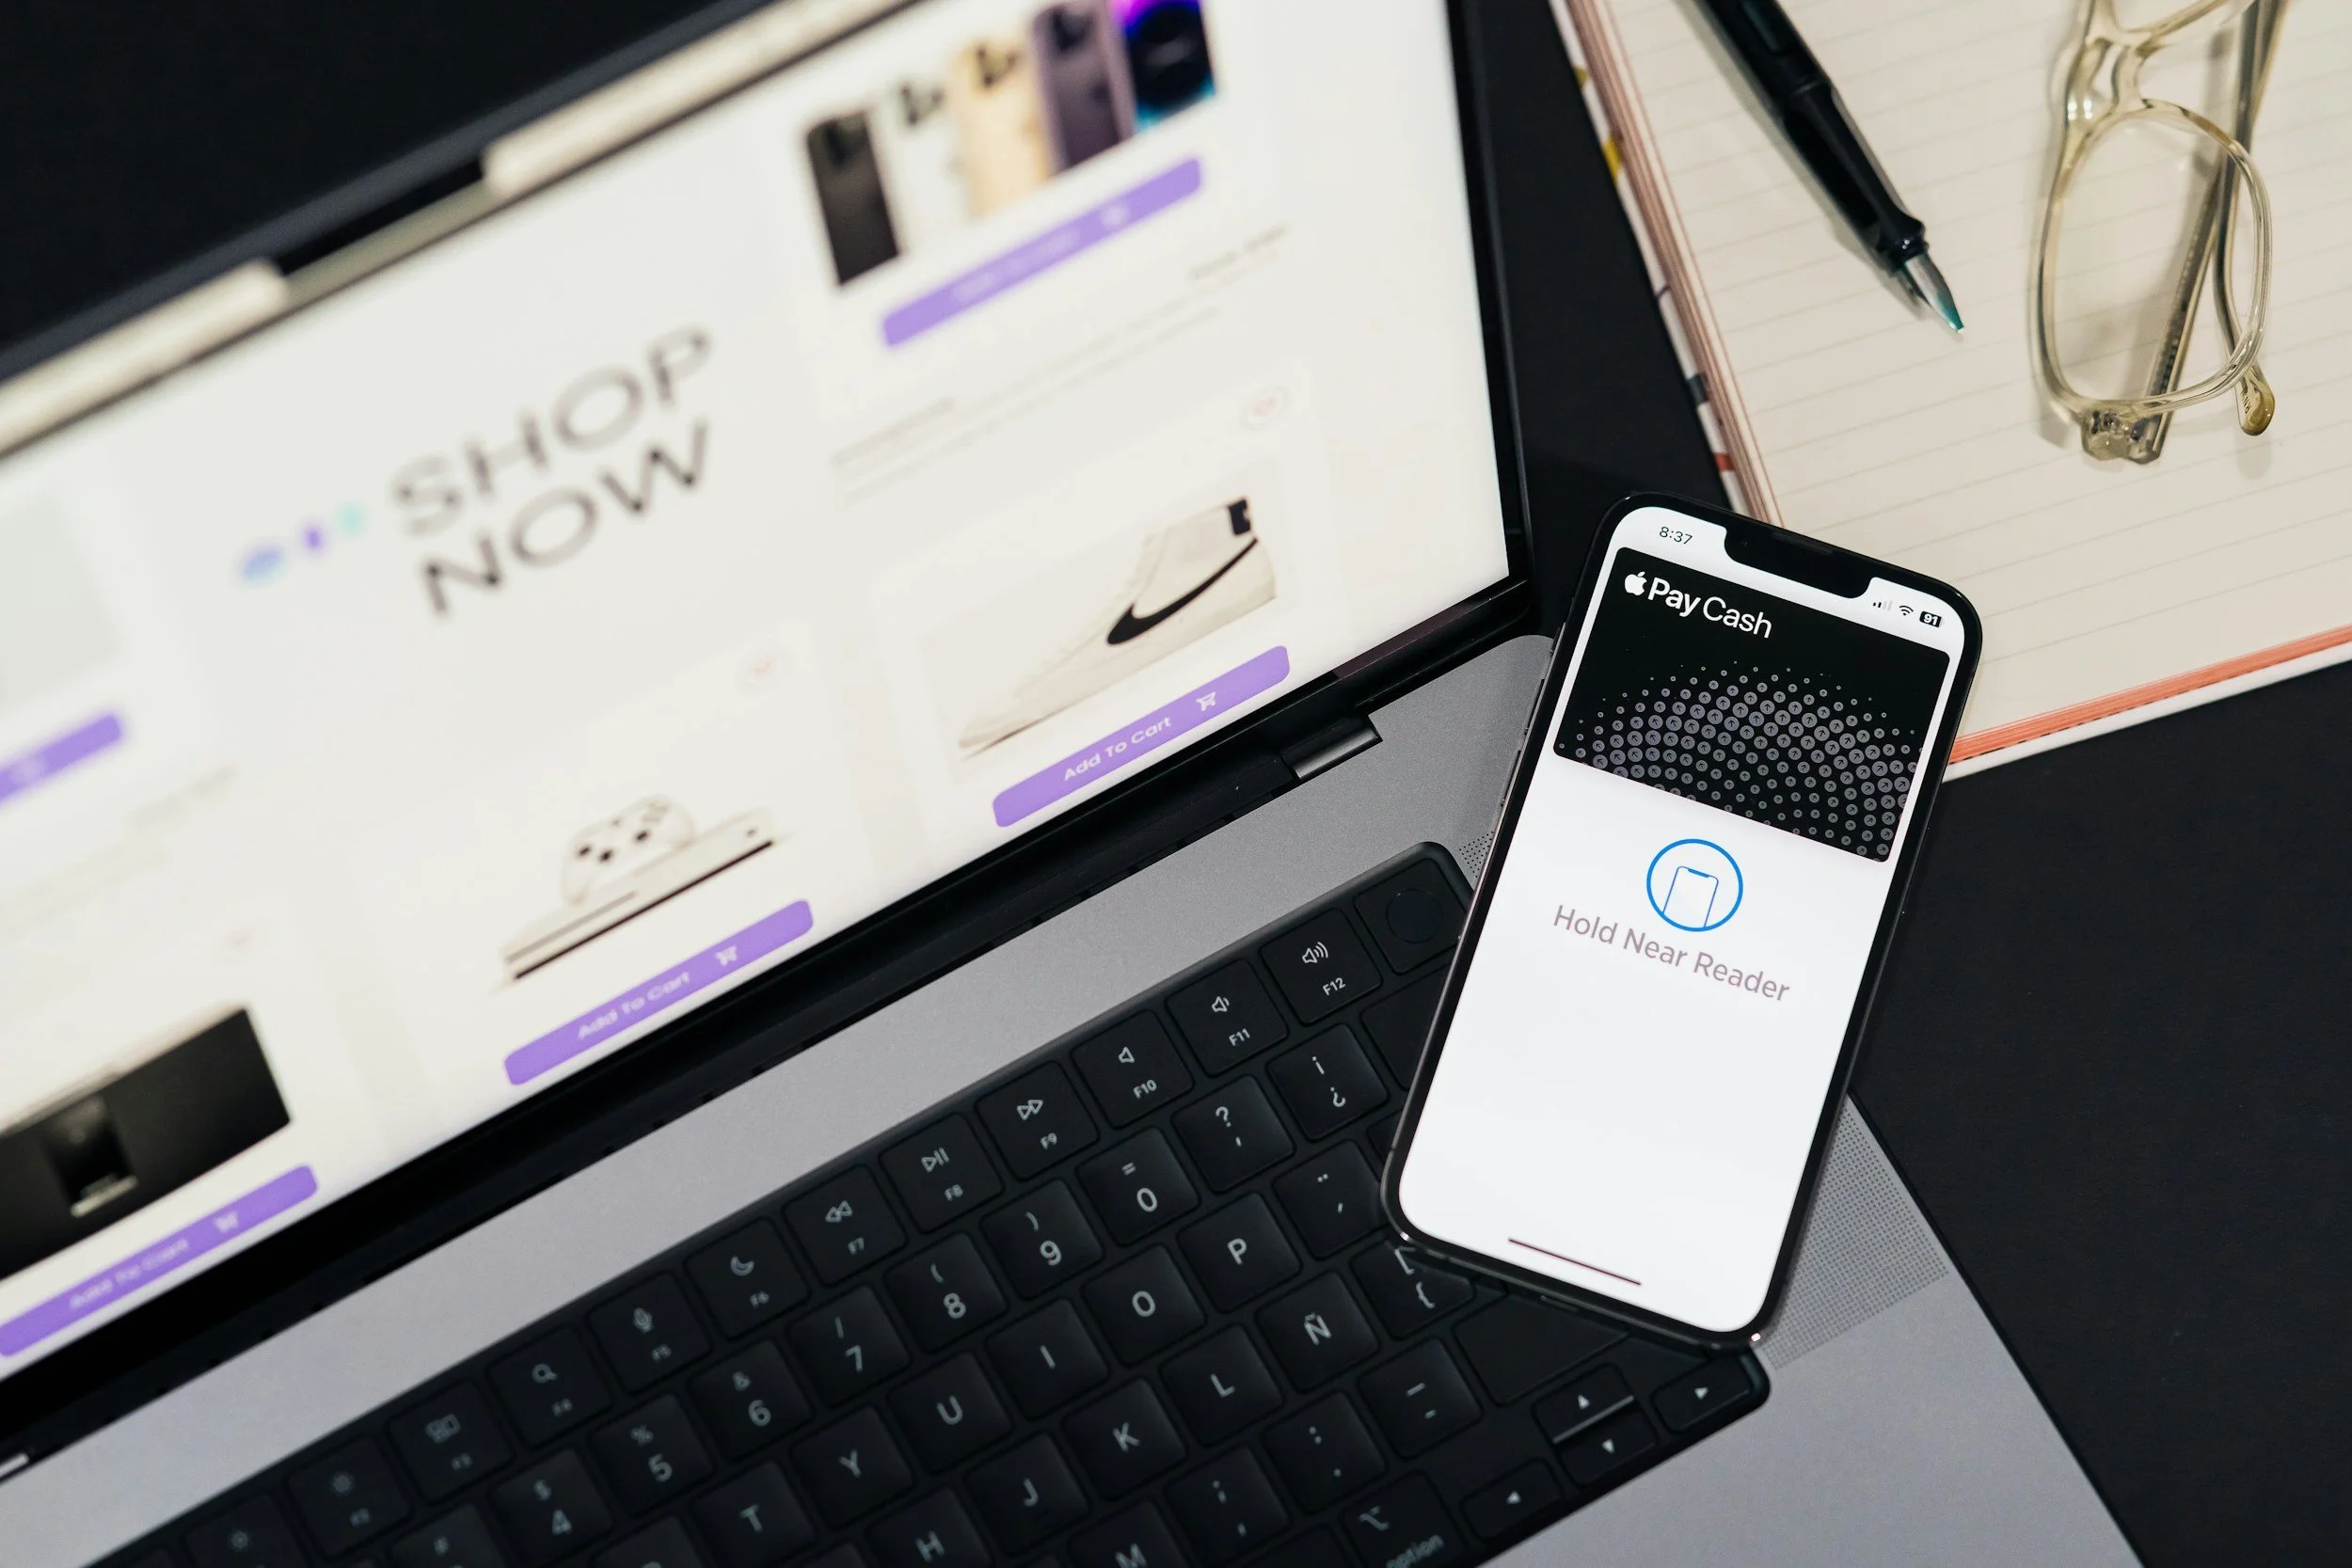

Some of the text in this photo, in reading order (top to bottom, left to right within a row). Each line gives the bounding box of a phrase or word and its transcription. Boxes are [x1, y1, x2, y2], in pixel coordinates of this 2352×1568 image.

[388, 325, 711, 536] SHOP
[420, 420, 709, 616] NOW
[1659, 526, 1693, 545] 8:37
[1647, 577, 1772, 639] Pay Cash
[1923, 613, 1938, 626] 91
[1064, 716, 1172, 781] Add To Cart
[1553, 905, 1789, 1001] Hold Near Reader
[1322, 976, 1346, 996] F12
[579, 1008, 618, 1041] Add
[1229, 1028, 1250, 1047] F11
[1133, 1079, 1157, 1099] F10
[1329, 1086, 1346, 1108] ¿
[1215, 1105, 1232, 1128] ?
[1040, 1132, 1057, 1149] F9
[1121, 1162, 1136, 1176] =
[944, 1184, 963, 1201] F8
[1025, 1212, 1040, 1231] )
[848, 1237, 865, 1255] F7
[1039, 1240, 1062, 1266] 9
[1227, 1238, 1248, 1265] P
[930, 1263, 944, 1283] (
[943, 1292, 966, 1319] 8
[1131, 1291, 1156, 1318] O
[1415, 1281, 1435, 1309] {
[1304, 1313, 1332, 1344] Ñ
[846, 1344, 863, 1371] 7
[1210, 1373, 1235, 1398] L
[748, 1399, 771, 1427] 6
[936, 1395, 963, 1425] U
[1113, 1422, 1139, 1451] K
[1309, 1426, 1322, 1445] :
[648, 1453, 673, 1482] 5
[840, 1450, 861, 1476] Y
[1023, 1478, 1039, 1507] J
[552, 1510, 572, 1534] 4
[740, 1504, 762, 1531] T
[916, 1531, 945, 1560] H
[1116, 1544, 1147, 1568] M
